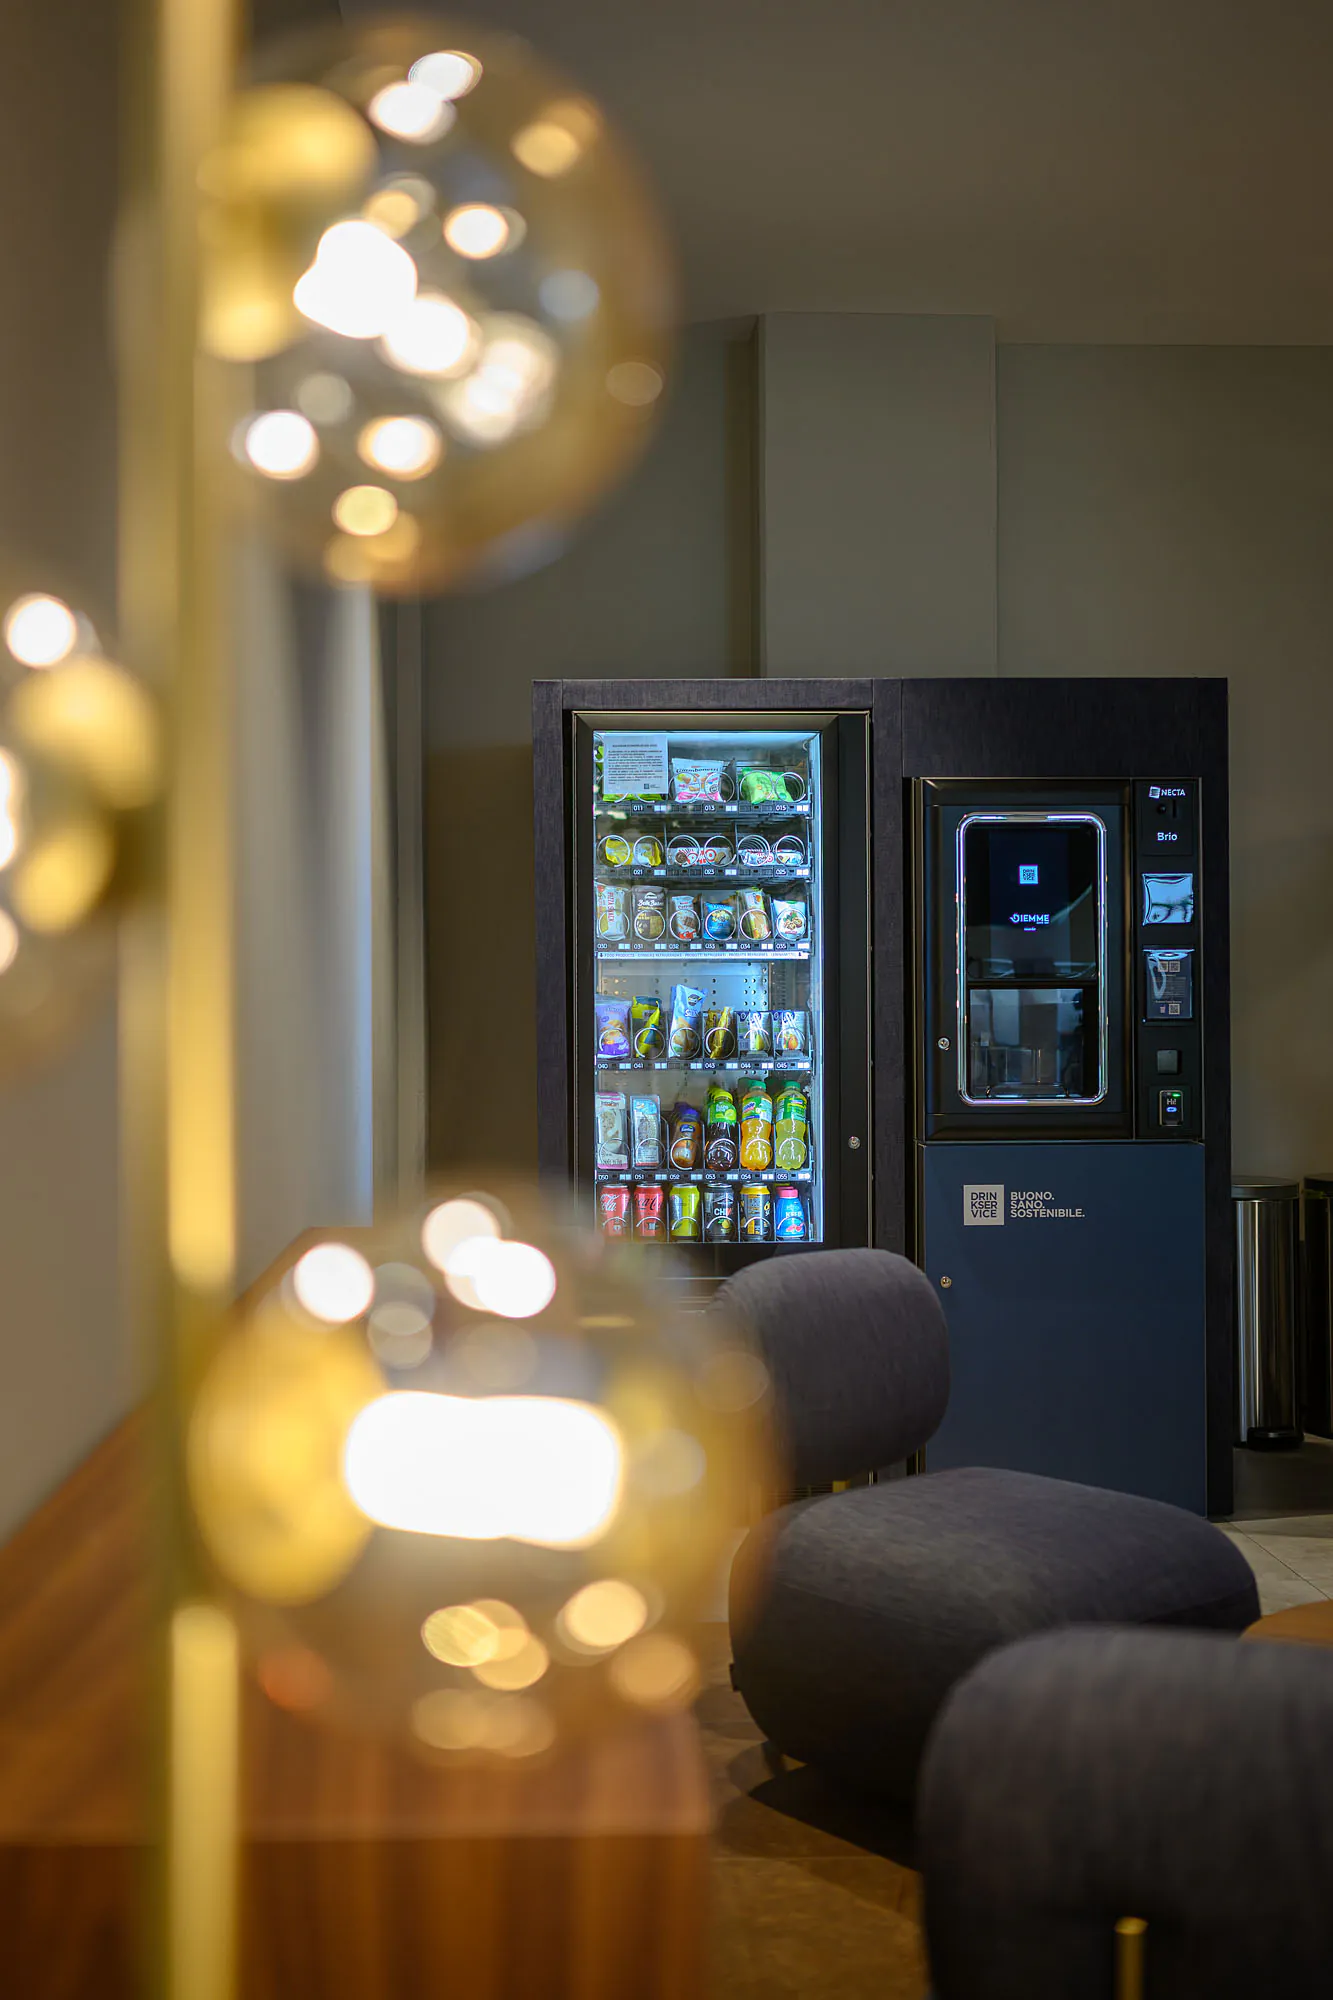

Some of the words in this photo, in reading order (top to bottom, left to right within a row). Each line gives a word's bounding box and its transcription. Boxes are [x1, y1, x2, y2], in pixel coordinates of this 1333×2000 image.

[1157, 832, 1178, 841] Brio
[971, 1192, 997, 1200] DRIN
[1010, 1192, 1055, 1200] BUONO.
[971, 1201, 998, 1209] KSER
[1010, 1200, 1045, 1209] SANO.
[971, 1210, 997, 1218] VICE
[1010, 1209, 1085, 1218] SOSTENIBILE.
